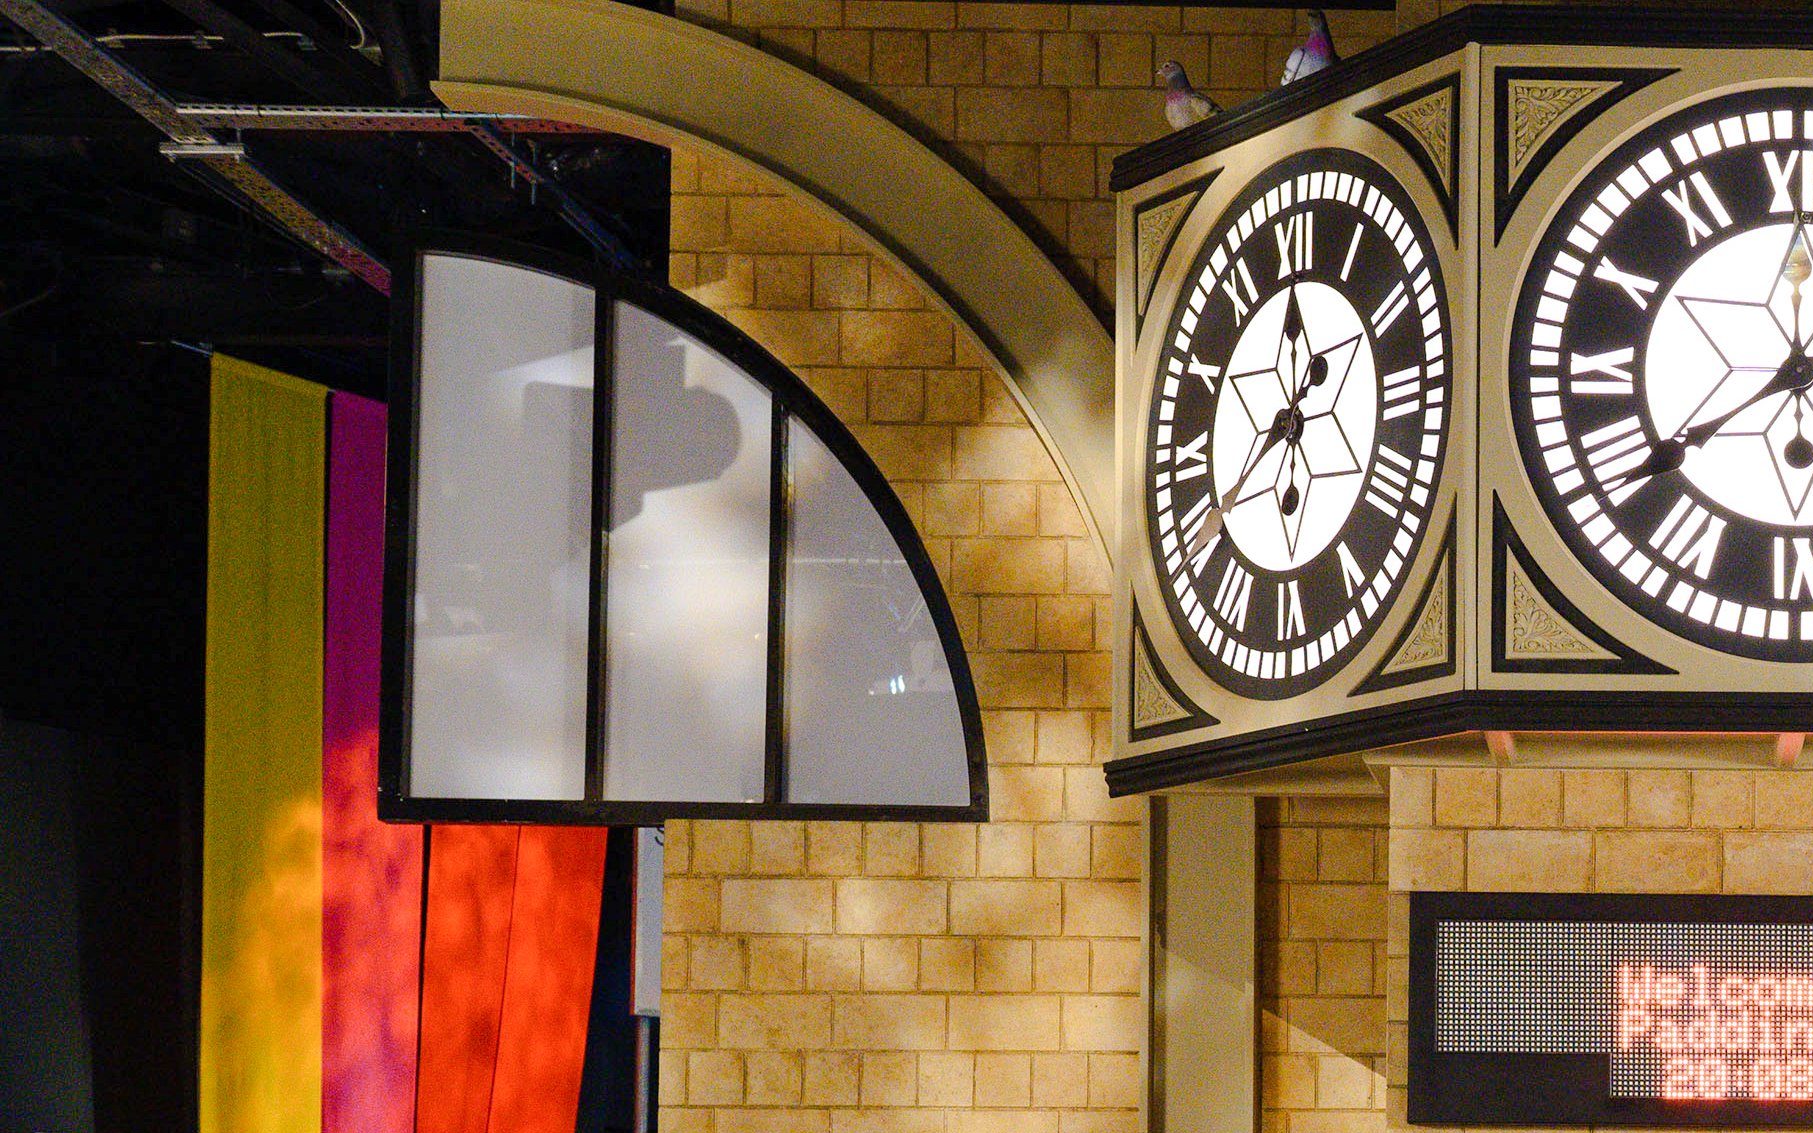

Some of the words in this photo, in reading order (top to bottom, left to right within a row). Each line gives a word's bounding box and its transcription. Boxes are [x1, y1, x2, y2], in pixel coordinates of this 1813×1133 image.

[1661, 171, 1733, 247] XI
[1274, 211, 1313, 280] XII
[1222, 257, 1259, 327] XI
[1371, 281, 1409, 338] II
[1594, 256, 1659, 310] X
[1188, 353, 1221, 394] X
[1336, 541, 1365, 598] V
